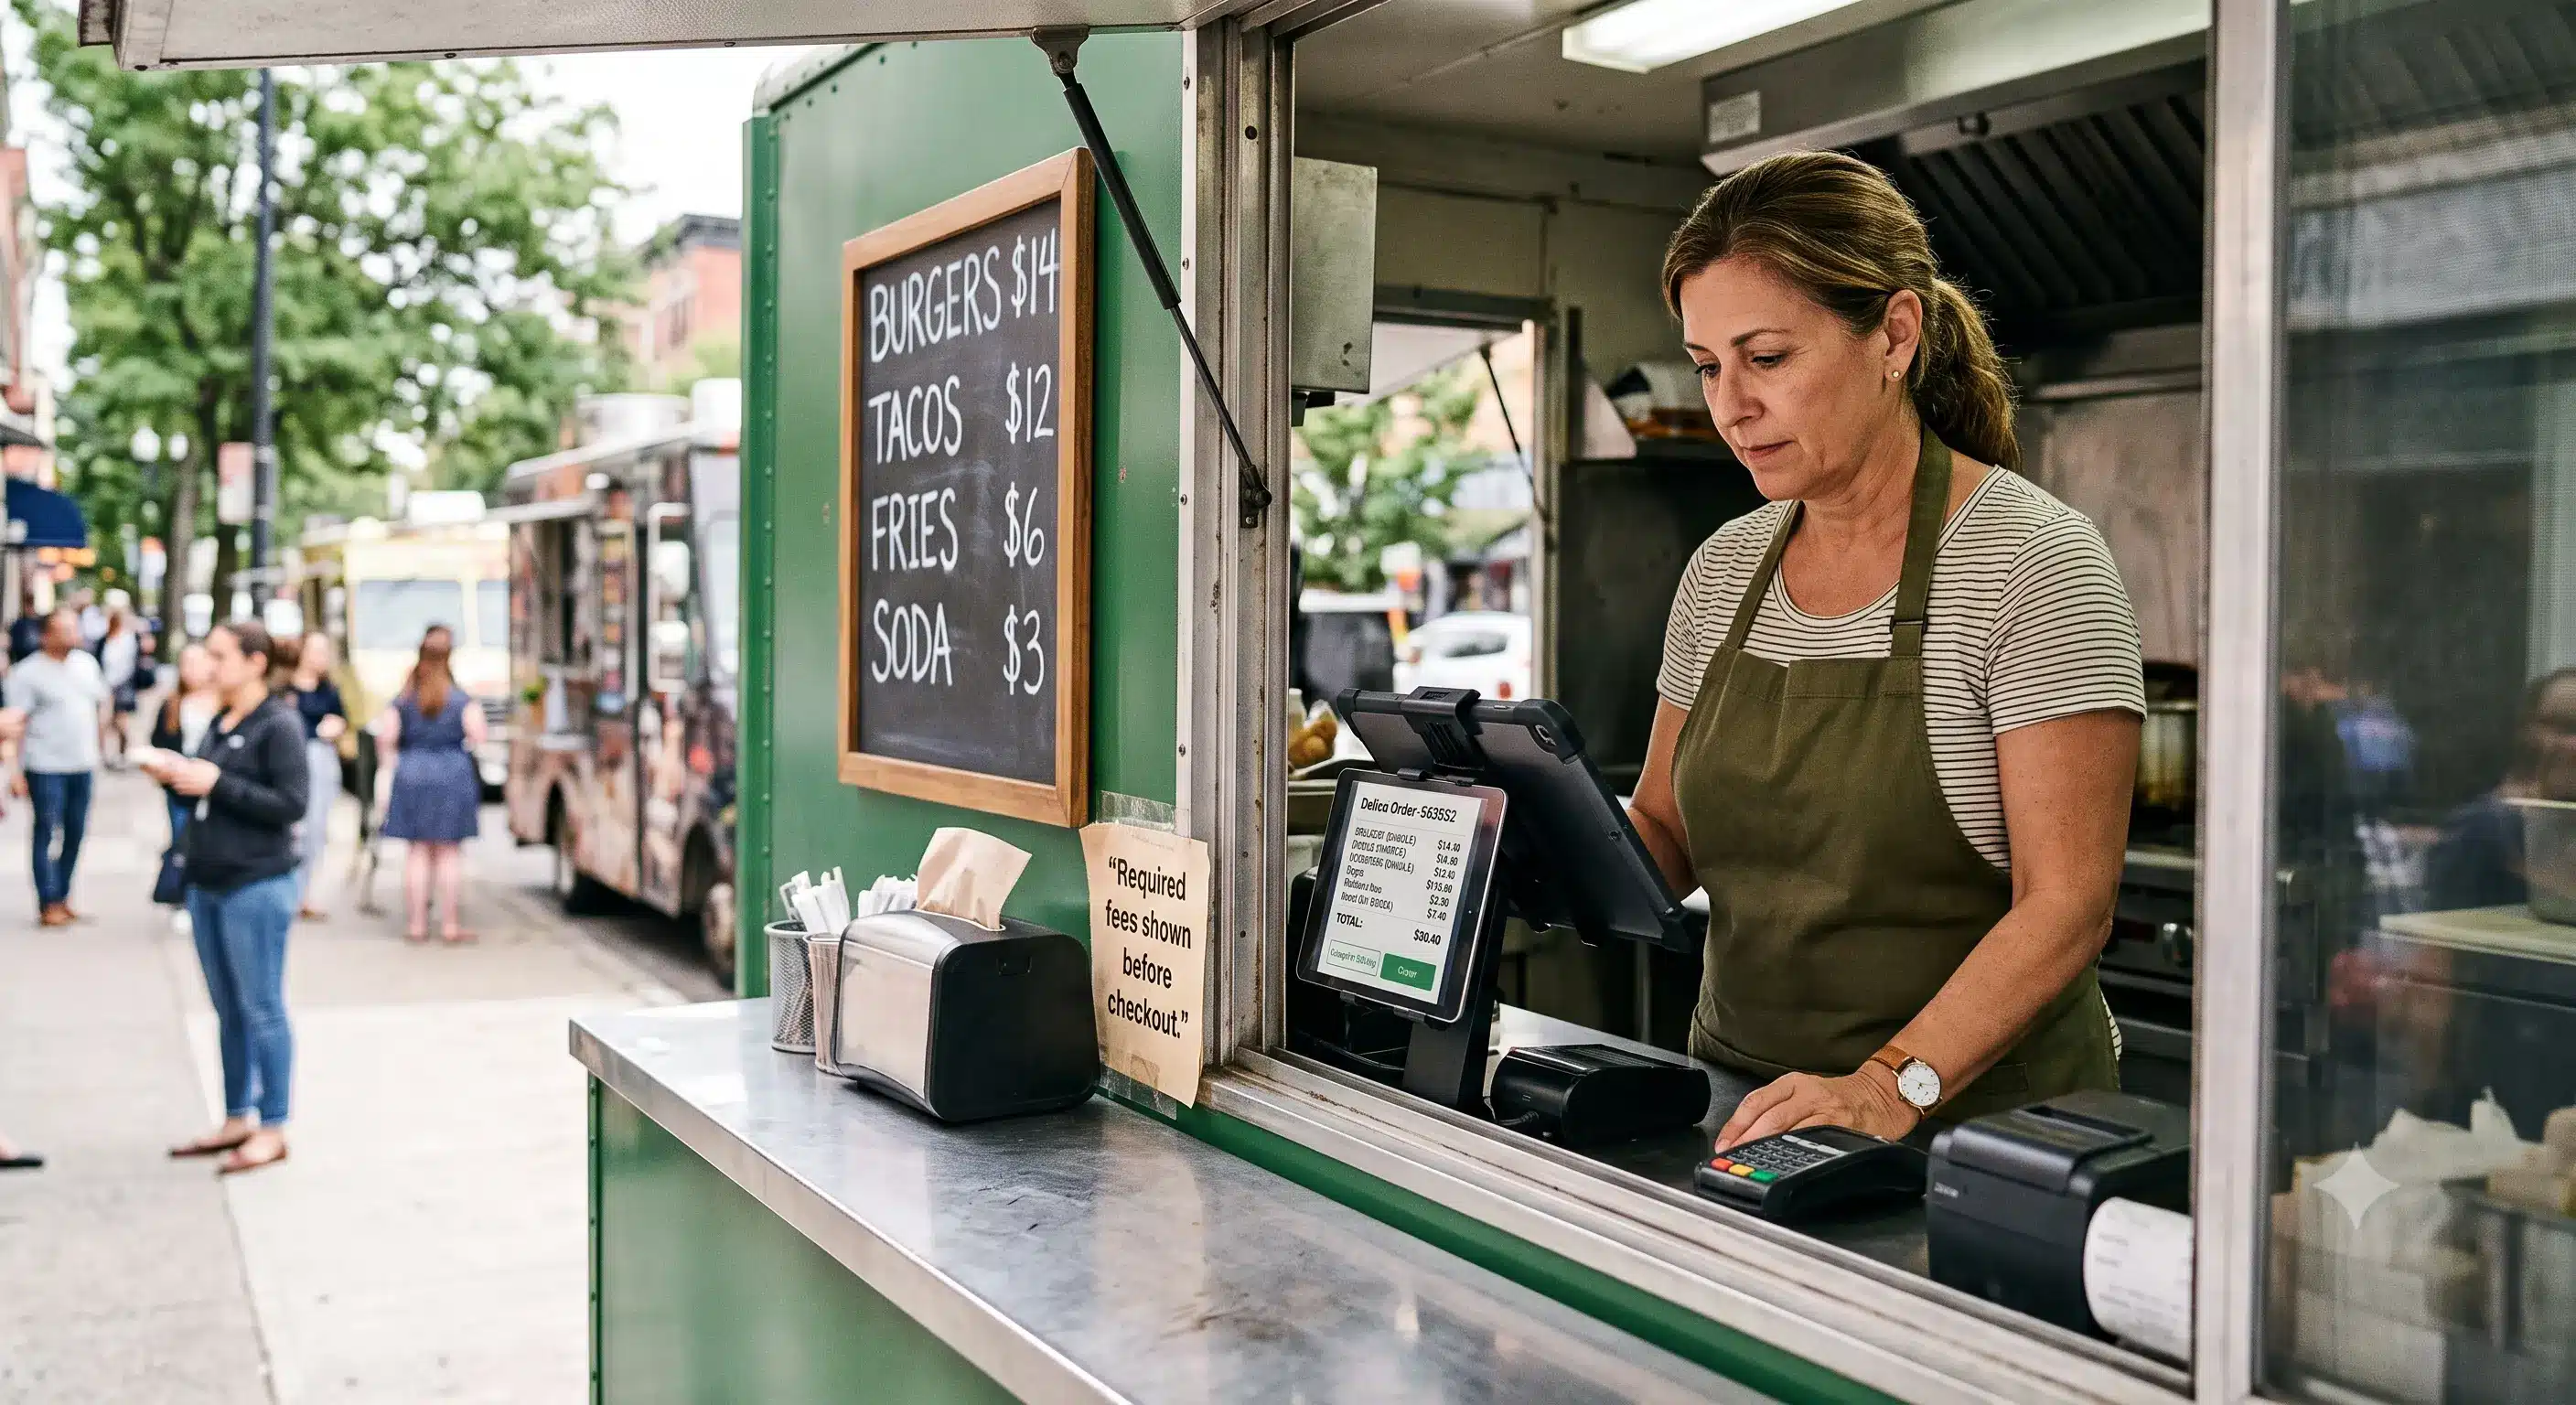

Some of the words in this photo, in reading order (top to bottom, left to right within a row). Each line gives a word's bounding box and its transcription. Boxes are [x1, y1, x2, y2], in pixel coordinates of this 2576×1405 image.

[870, 244, 1002, 363] BURGERS
[1011, 227, 1059, 318] $14
[868, 375, 961, 464] TACOS
[1004, 361, 1055, 445] $12
[872, 488, 959, 573] FRIES
[1004, 481, 1045, 568] $6
[871, 599, 953, 687] SODA
[1003, 605, 1045, 696] $3
[1360, 797, 1389, 813] Delica
[1105, 898, 1138, 934] fees
[1142, 909, 1191, 949] shown
[1336, 912, 1364, 928] TOTAL:
[1413, 928, 1442, 946] $30.40
[1427, 907, 1447, 921] $7.40
[1122, 947, 1172, 990] before
